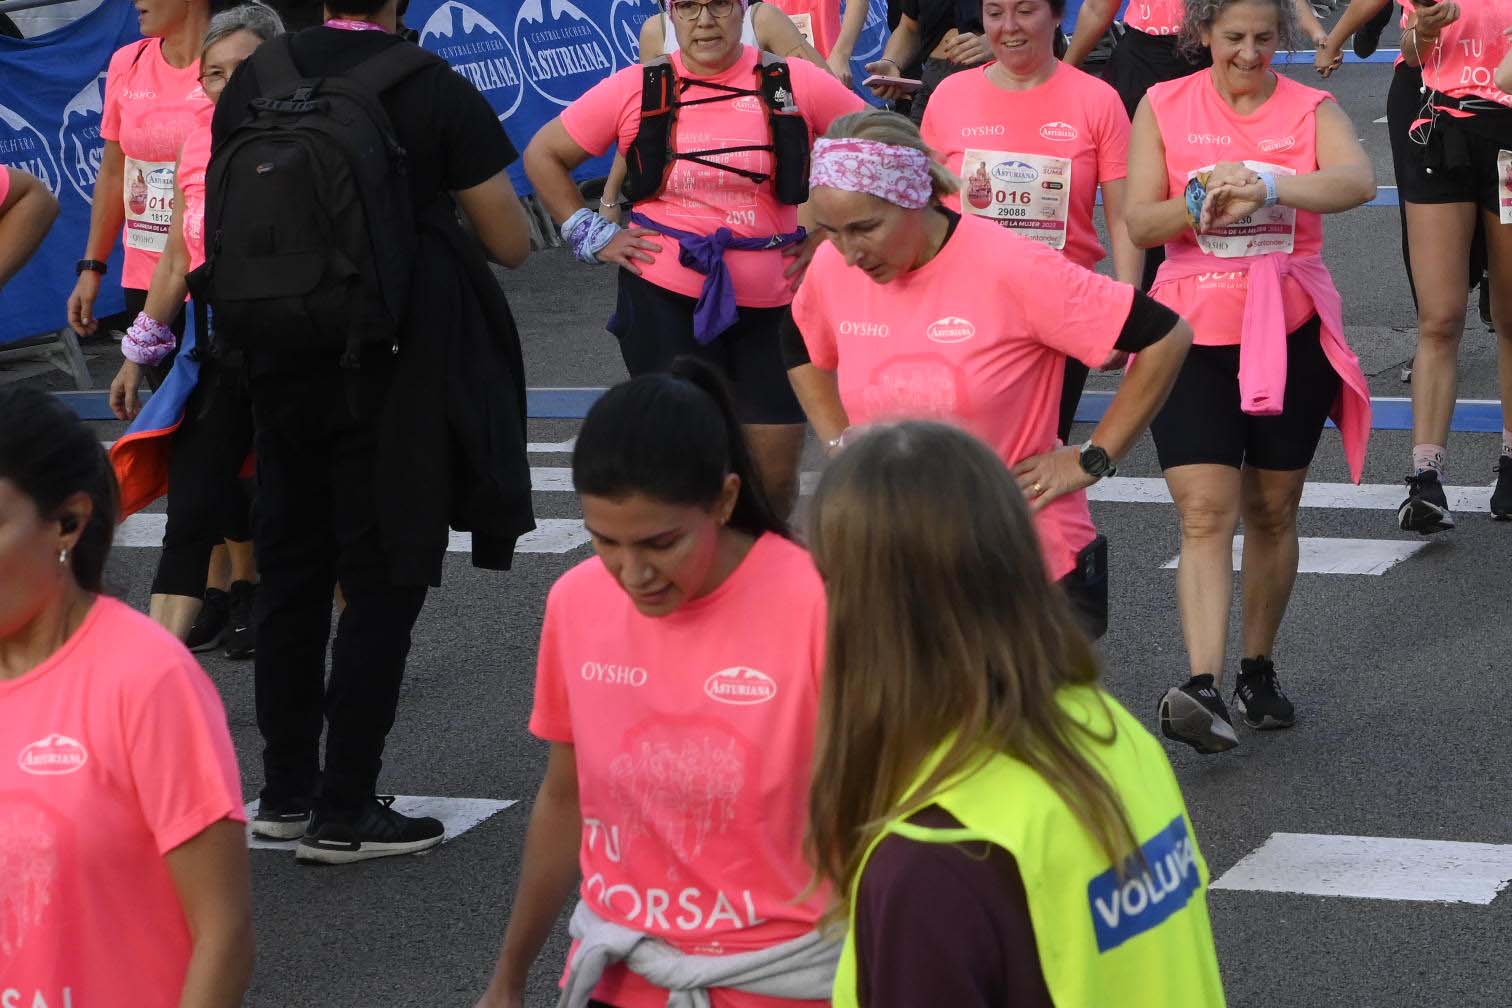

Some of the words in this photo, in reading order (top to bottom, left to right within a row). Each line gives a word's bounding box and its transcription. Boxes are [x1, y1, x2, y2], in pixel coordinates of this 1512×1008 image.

[1459, 39, 1483, 58] TU
[523, 37, 610, 81] ASTURIANA
[452, 56, 519, 92] TURIANA
[996, 166, 1035, 179] ASTURIANA
[995, 190, 1032, 204] 016
[725, 210, 756, 225] 2019
[998, 207, 1026, 217] 29088
[839, 320, 890, 338] OYSHO
[581, 661, 648, 688] OYSHO
[709, 679, 772, 696] ASTURIANA
[584, 817, 621, 863] TU
